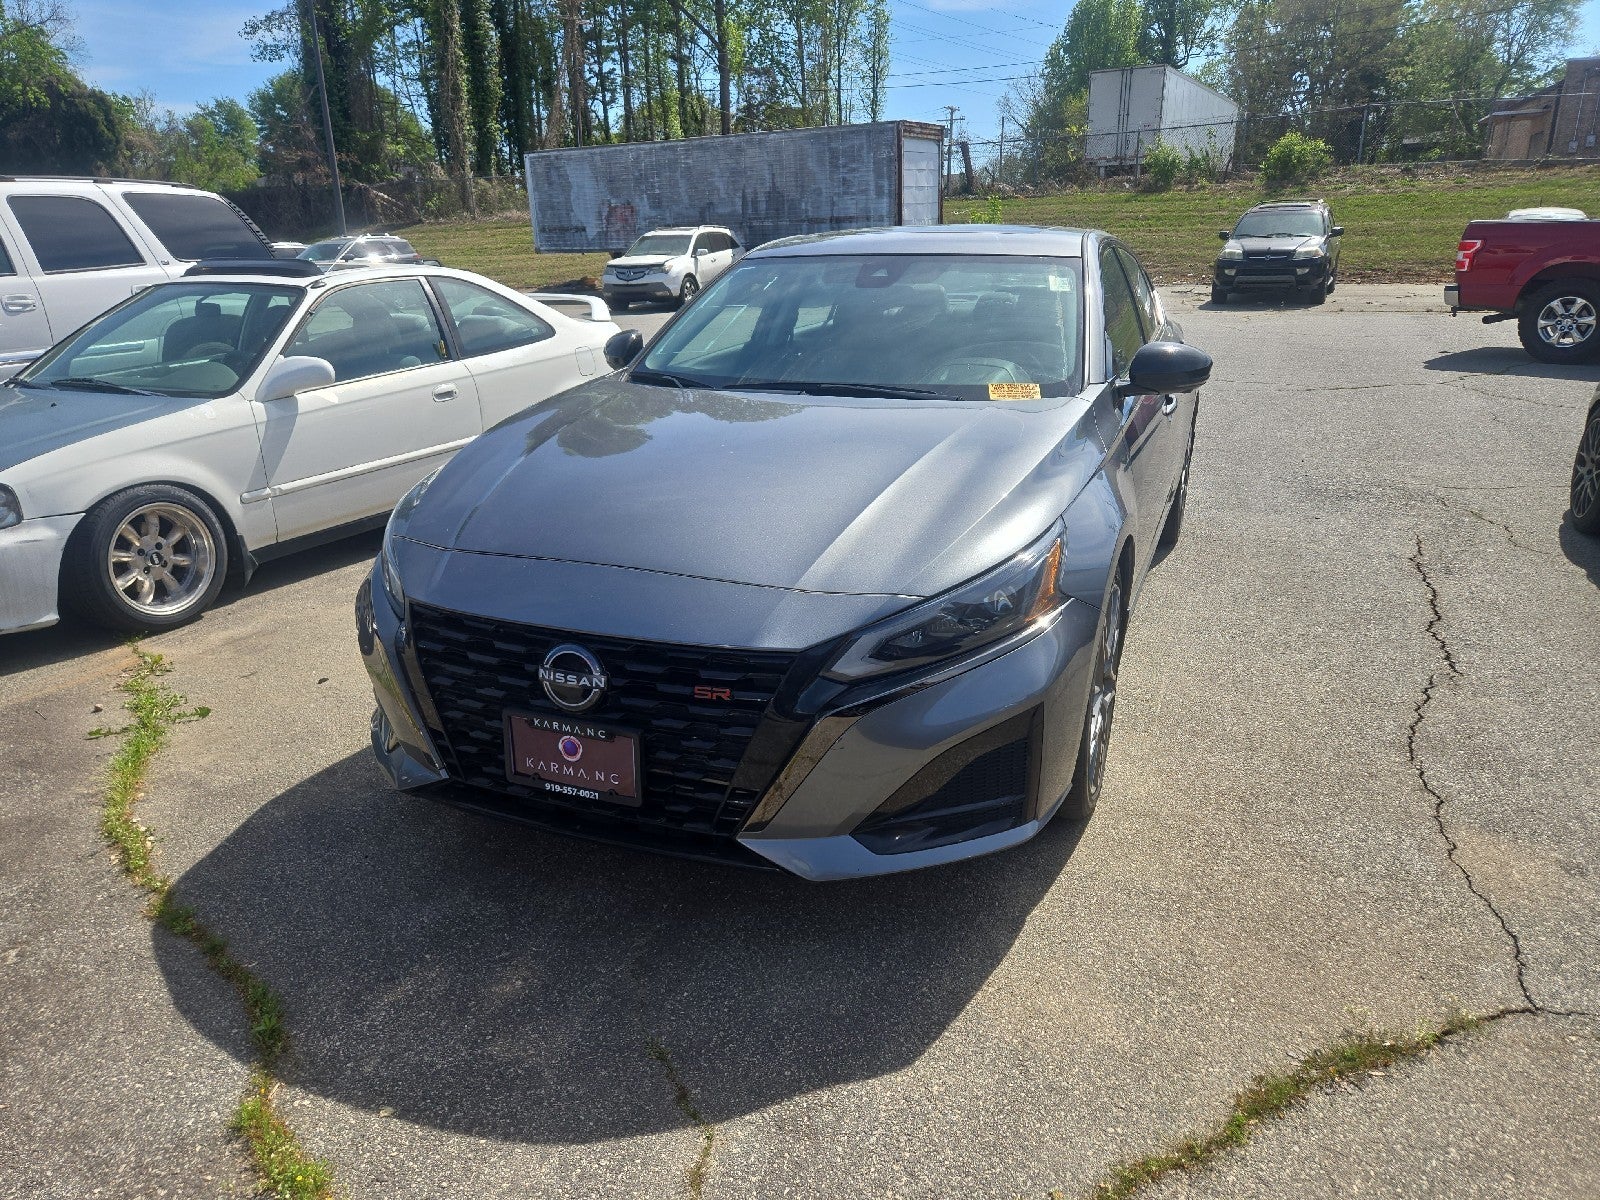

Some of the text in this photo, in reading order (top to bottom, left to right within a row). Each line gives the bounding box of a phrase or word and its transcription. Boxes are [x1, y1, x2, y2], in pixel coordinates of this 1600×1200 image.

[538, 667, 606, 689] NISSAN
[694, 685, 732, 701] SR
[545, 783, 599, 800] 919-557-0021
